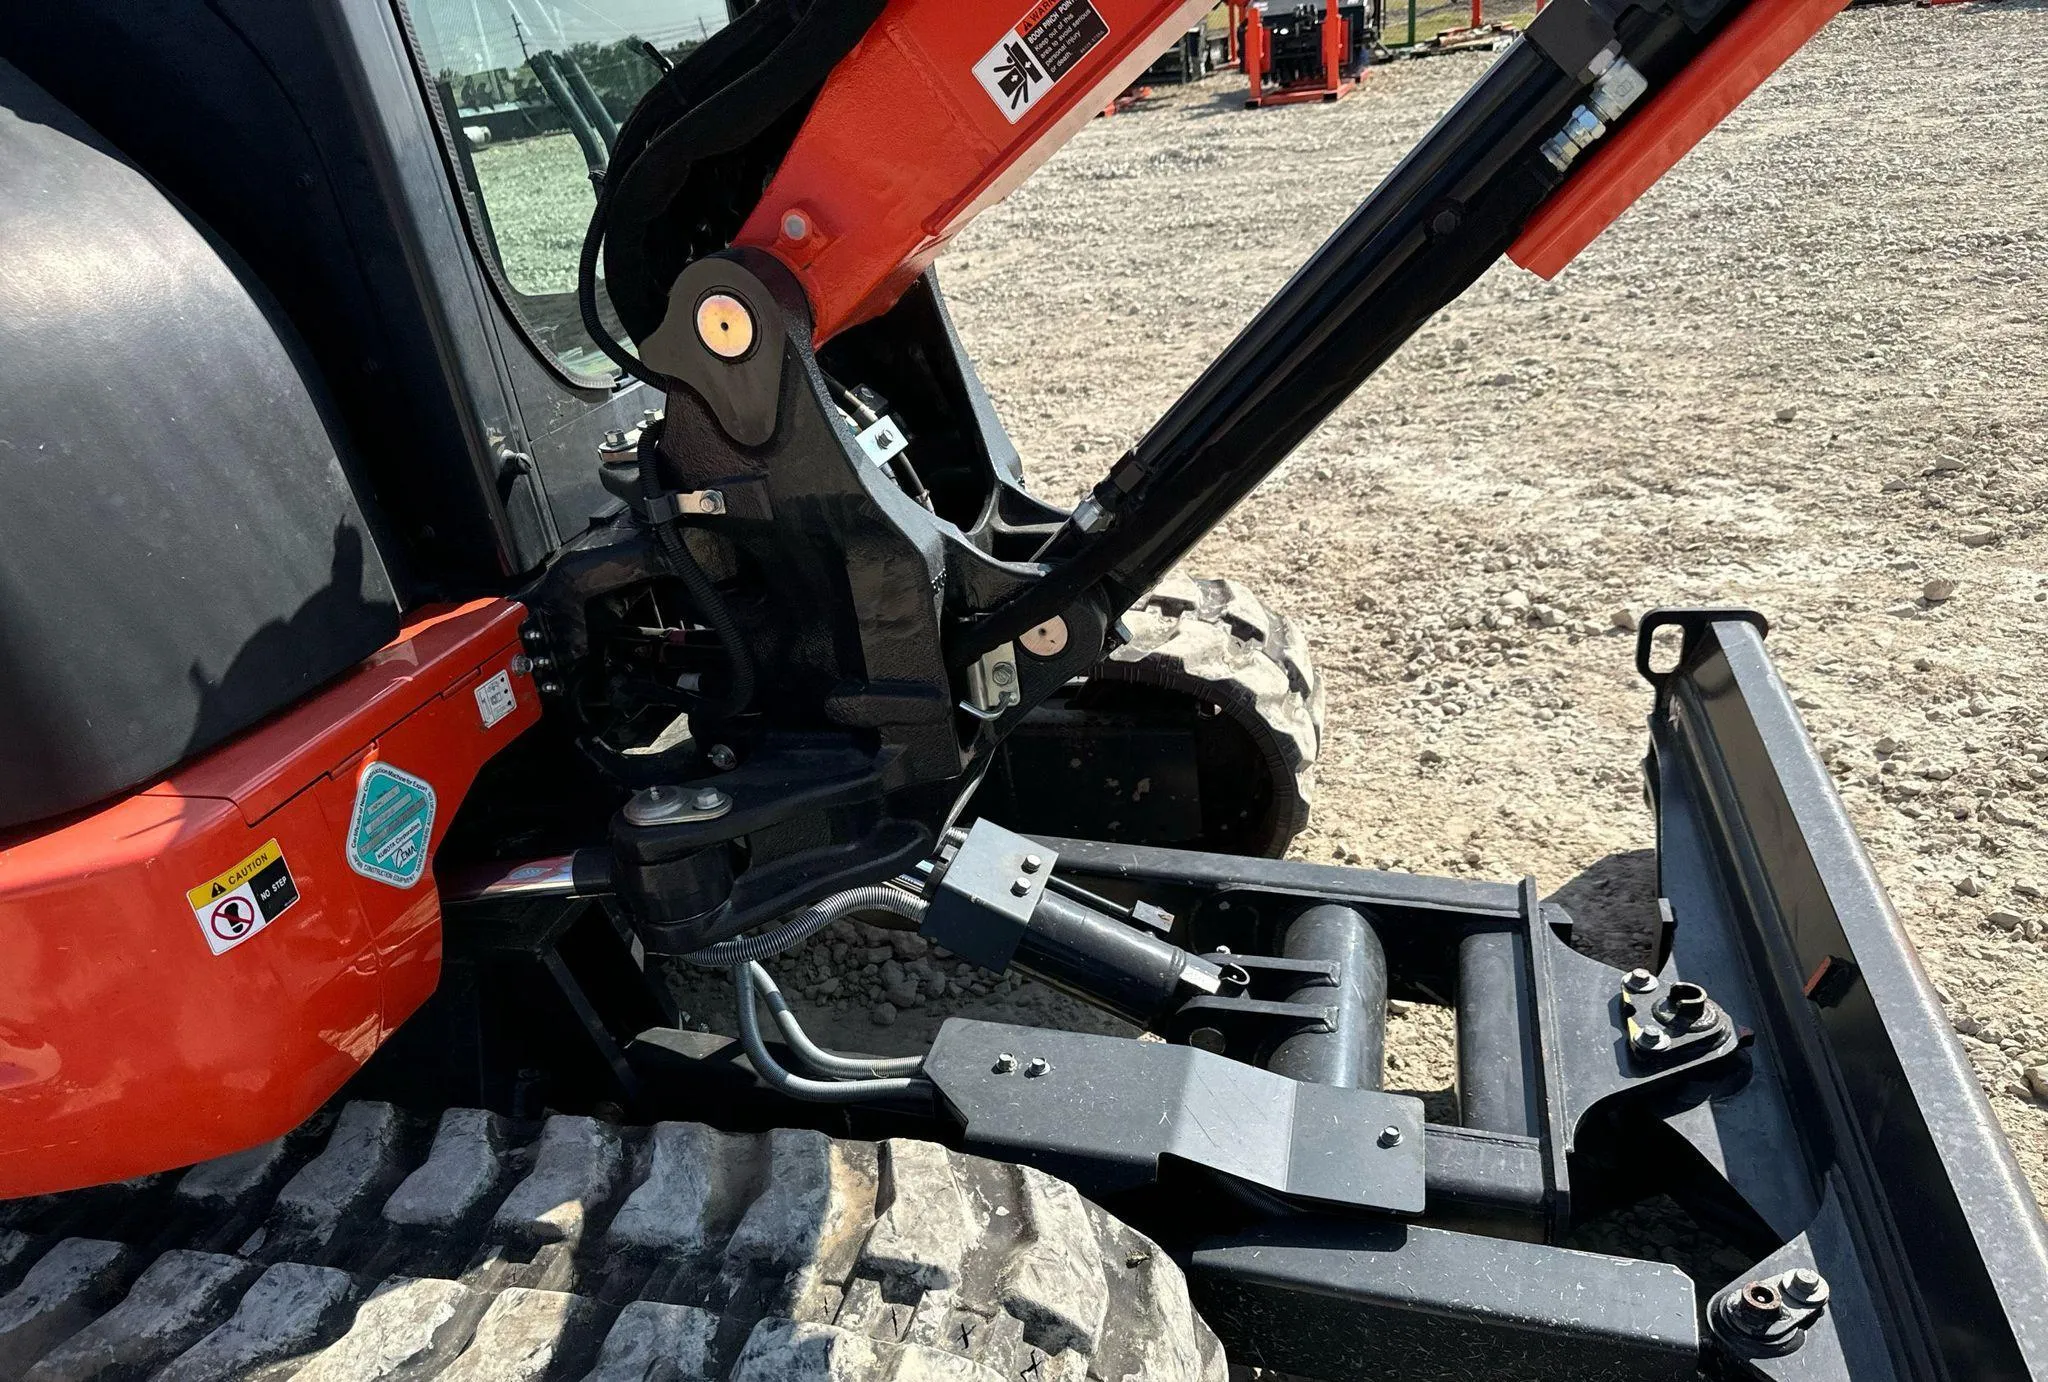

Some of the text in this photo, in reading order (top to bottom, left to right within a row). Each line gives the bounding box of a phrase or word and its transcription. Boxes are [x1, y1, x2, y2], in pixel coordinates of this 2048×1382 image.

[1027, 26, 1045, 44] BOOM
[1042, 11, 1060, 29] PINCH
[1034, 13, 1074, 52] Keep out of this
[1040, 46, 1053, 59] area
[1051, 40, 1059, 48] to
[1058, 26, 1073, 42] avoid
[1073, 9, 1092, 28] serious
[1045, 43, 1067, 67] personal
[1066, 31, 1081, 46] injury
[1050, 65, 1057, 73] or
[377, 842, 396, 859] KUBOTA
[228, 853, 268, 885] CAUTION
[260, 875, 287, 901] NO STEP
